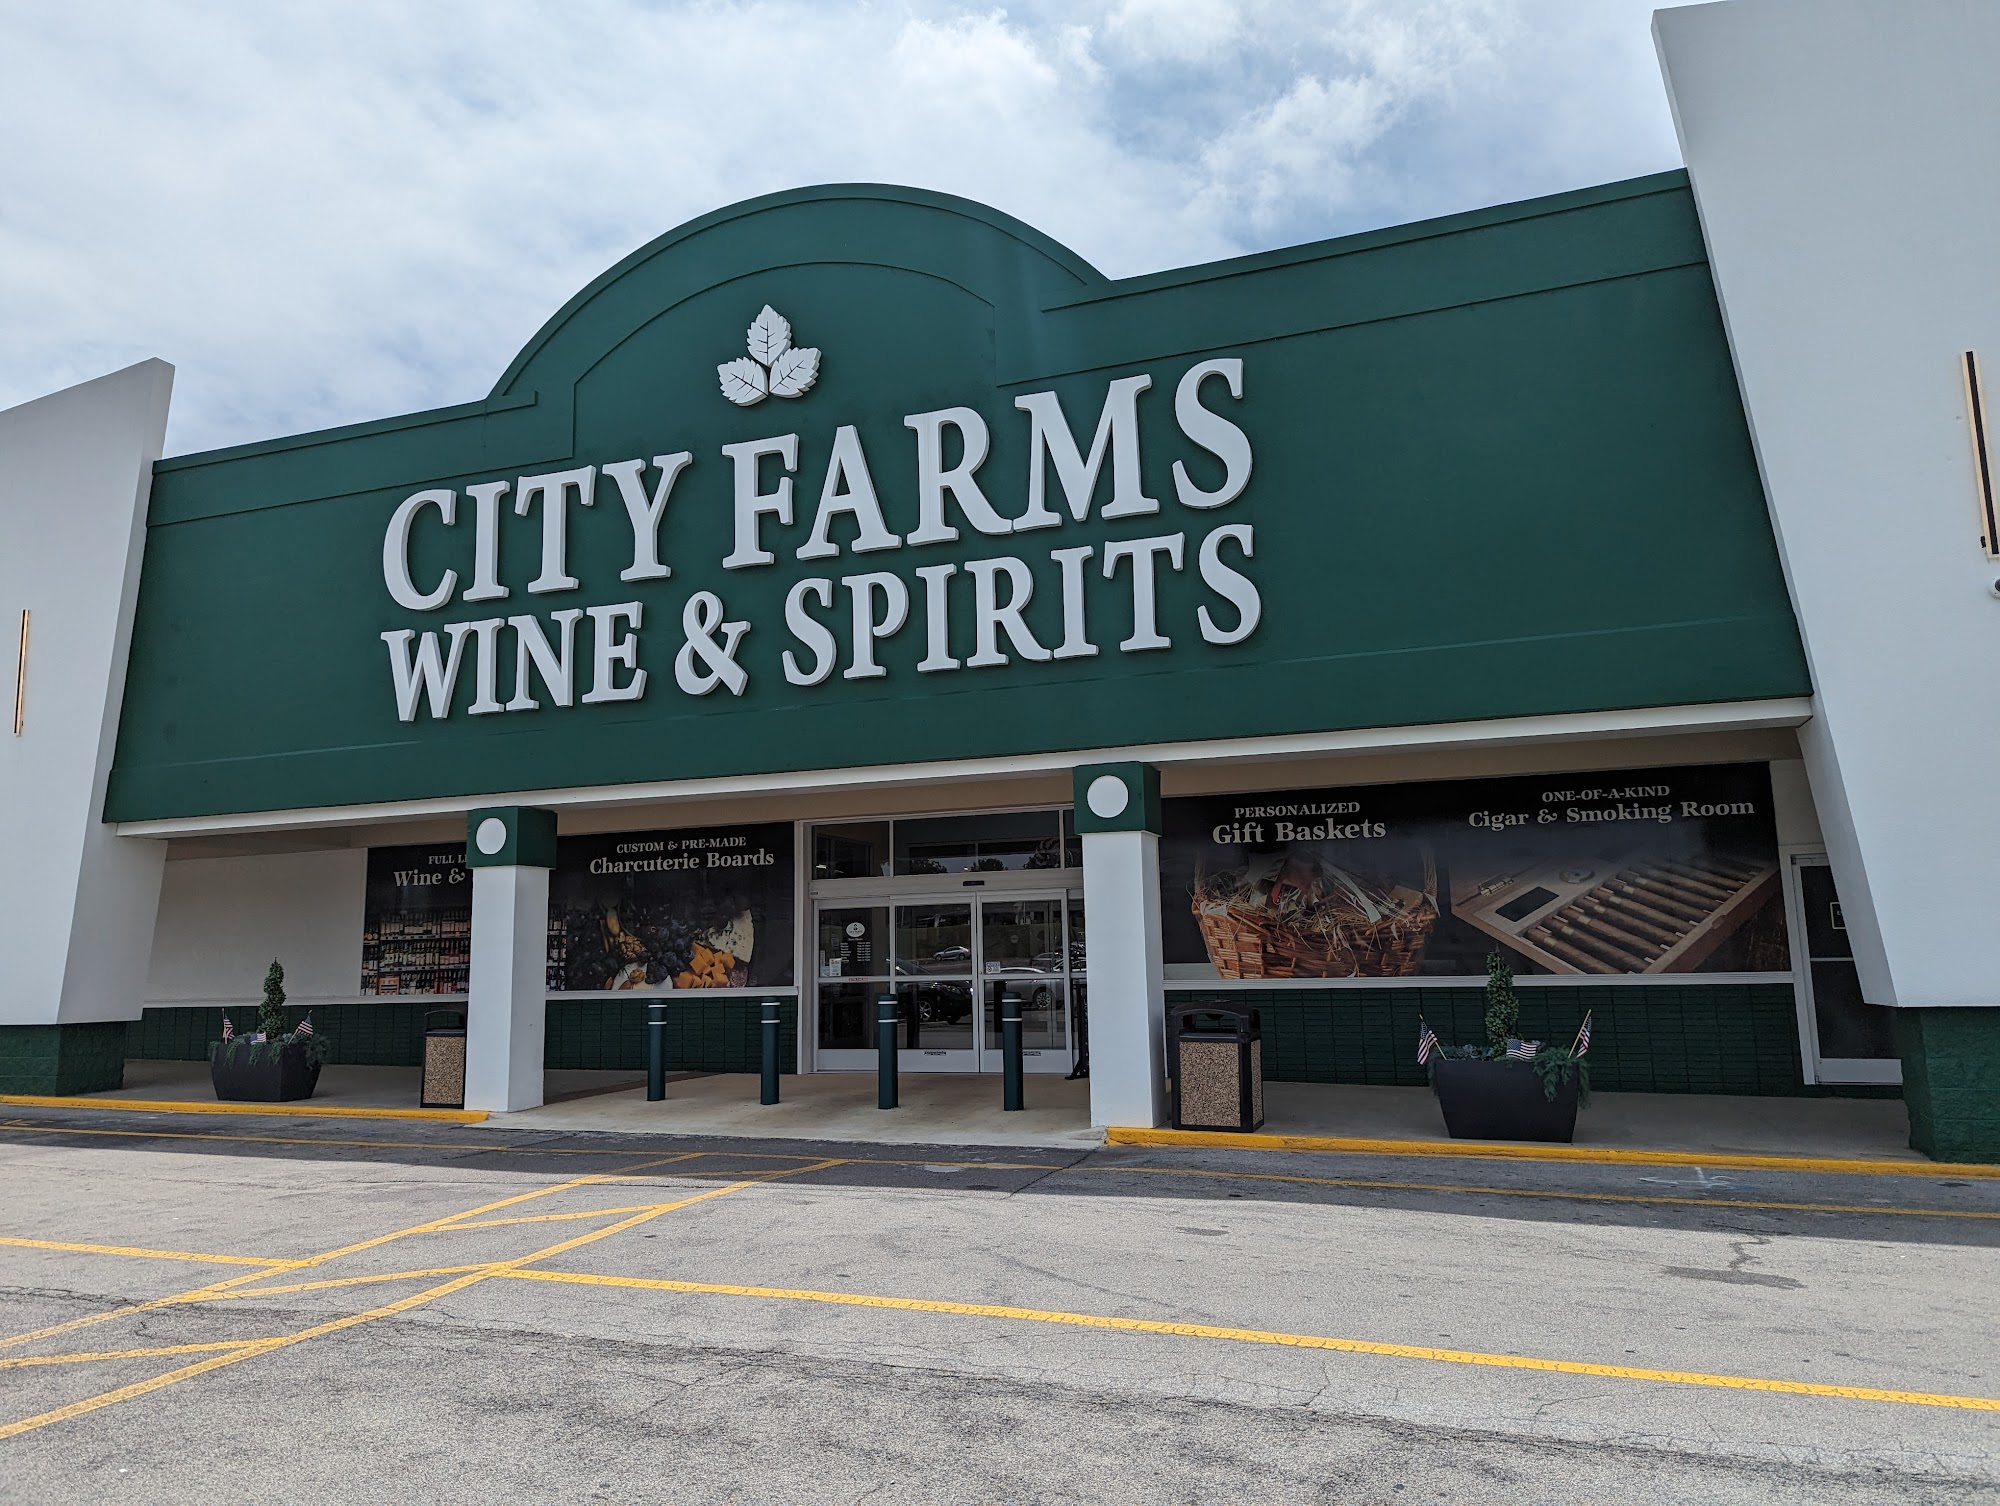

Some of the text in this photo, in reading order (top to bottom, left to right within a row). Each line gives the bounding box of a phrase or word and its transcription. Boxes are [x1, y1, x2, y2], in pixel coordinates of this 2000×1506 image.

[382, 358, 1253, 611] CITY FARMS
[381, 523, 1262, 722] WINE & SPIRITS
[1541, 785, 1671, 803] ONE-OF-A-KIND
[1234, 801, 1361, 818] PERSONALIZED
[1468, 799, 1756, 832] Cigar & Smoking Room
[1212, 817, 1387, 845] Gift Baskets
[616, 836, 747, 854] CUSTOM & PRE-MADE
[428, 855, 455, 865] FULL
[589, 848, 775, 875] Charcuterie Boards
[393, 867, 466, 887] Wine &
